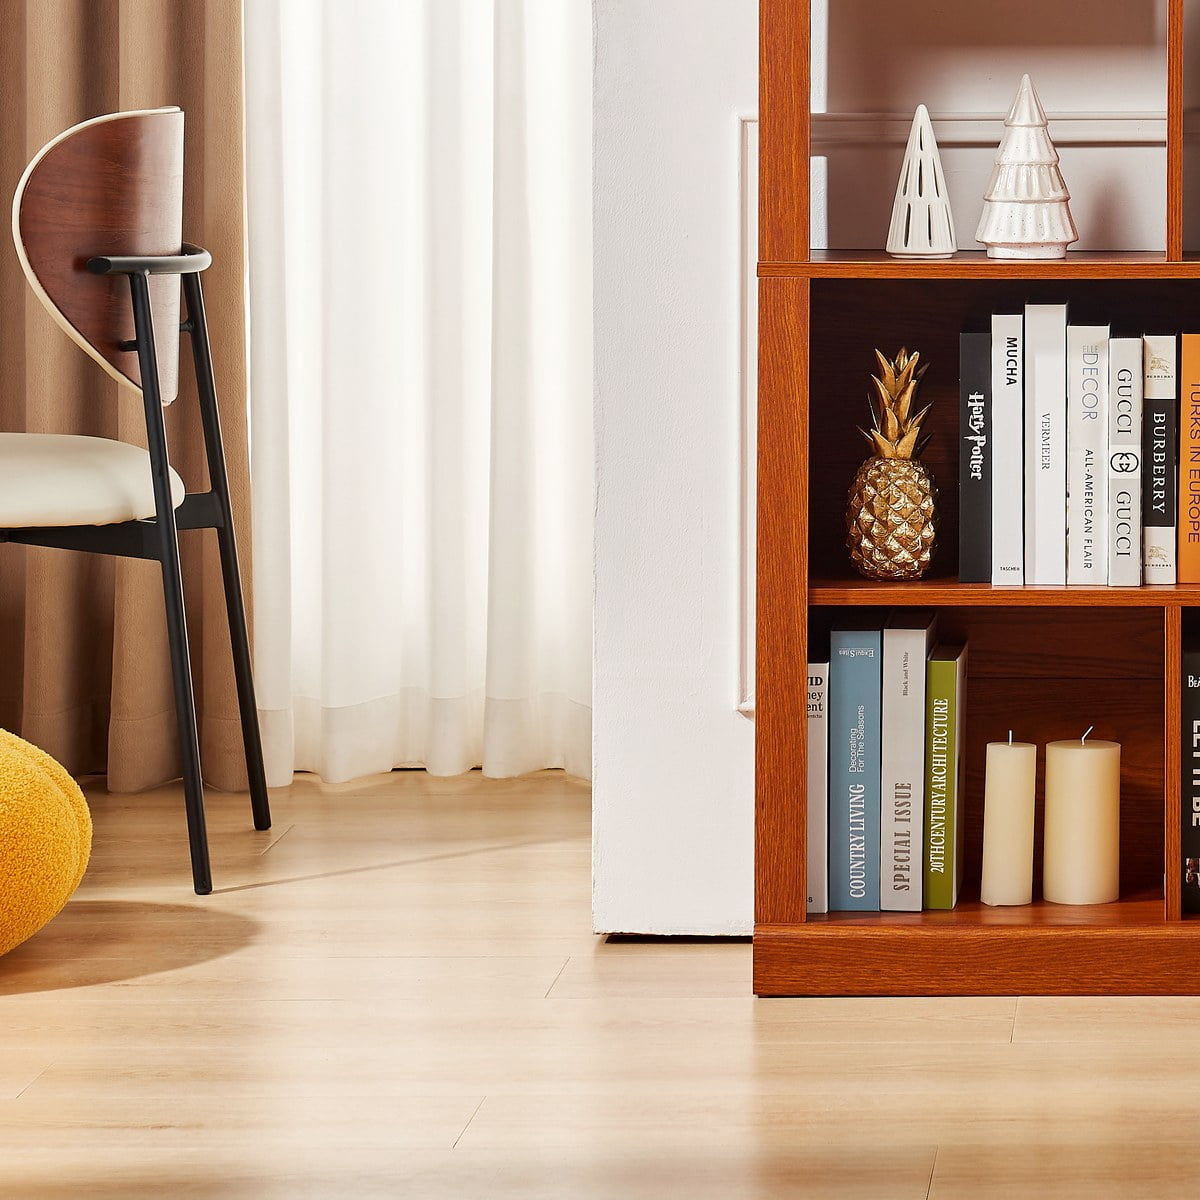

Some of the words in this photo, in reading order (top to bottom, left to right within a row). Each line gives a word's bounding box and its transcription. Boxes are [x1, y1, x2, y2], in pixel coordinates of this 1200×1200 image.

[1006, 337, 1018, 386] MUCHA
[1081, 353, 1099, 421] DECOR
[1116, 368, 1133, 434] GUCCI
[967, 391, 985, 434] Harry
[963, 434, 987, 480] Potter
[1041, 412, 1051, 470] VERMEER
[1152, 413, 1166, 514] BURBERRY
[1189, 446, 1200, 463] IN
[1083, 448, 1094, 533] ALL-AMERICAN
[1188, 469, 1200, 543] EUROPE
[1115, 491, 1132, 557] GUCCI
[1083, 538, 1093, 569] FLAIR
[856, 705, 865, 740] Seasons
[931, 698, 949, 791] ARCHITECTURE
[848, 728, 858, 773] Decorating
[857, 741, 865, 758] The
[857, 759, 865, 773] For
[848, 783, 865, 832] LIVING
[894, 782, 912, 823] ISSUE
[849, 834, 866, 898] COUNTRY
[893, 830, 911, 891] SPECIAL
